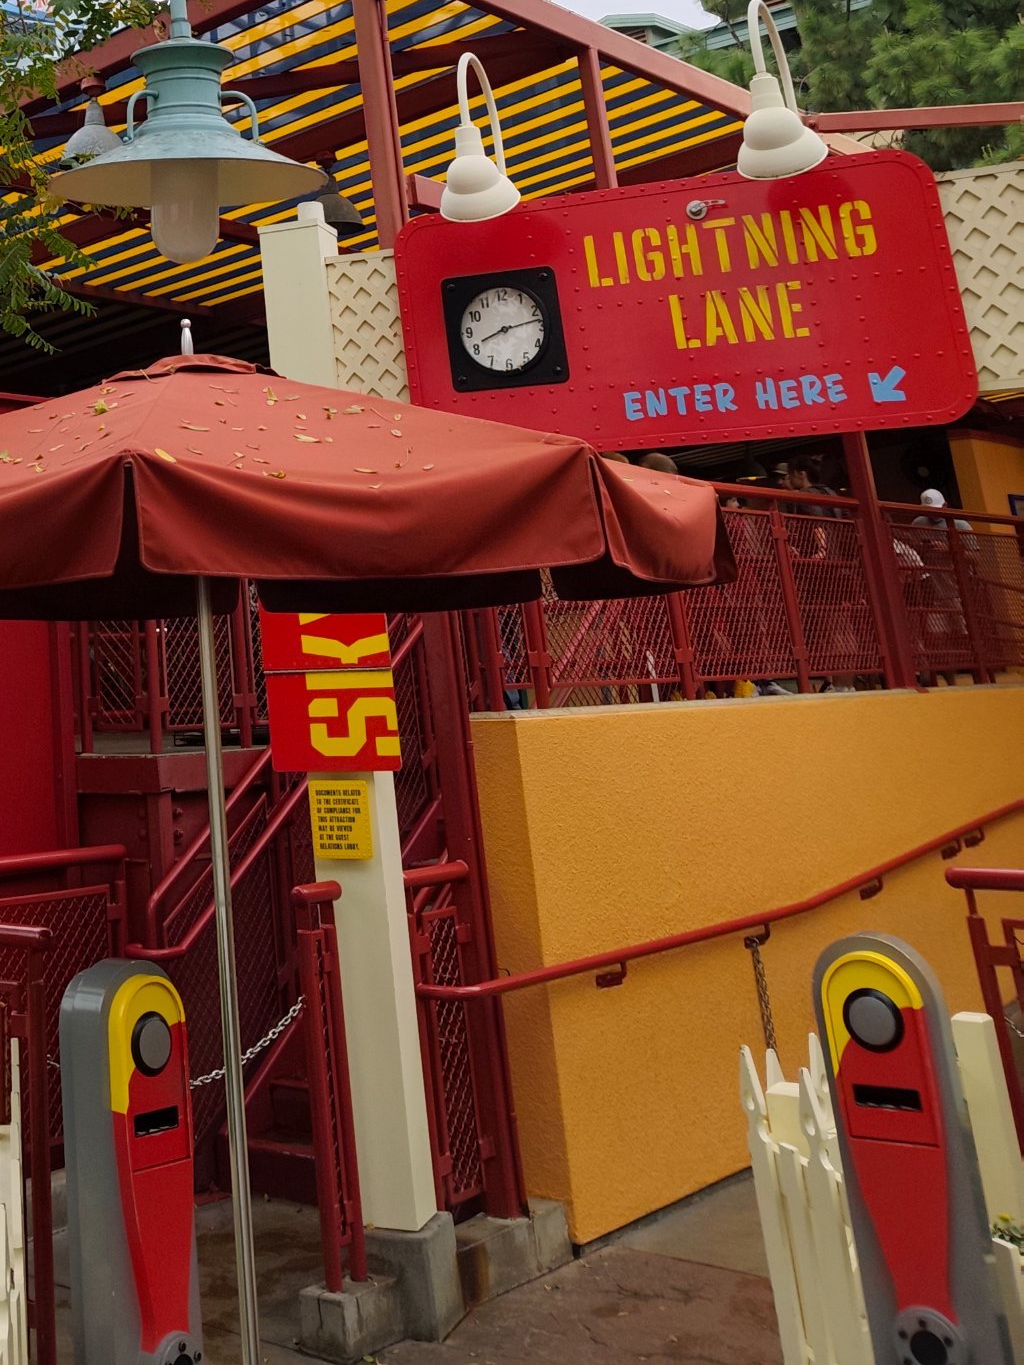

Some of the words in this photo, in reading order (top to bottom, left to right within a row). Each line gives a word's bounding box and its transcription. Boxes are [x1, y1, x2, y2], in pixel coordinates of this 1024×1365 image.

[583, 200, 878, 288] LIGHTNING
[496, 288, 508, 302] 12
[517, 293, 523, 305] 1
[479, 297, 490, 309] 11
[468, 310, 481, 323] 10
[531, 305, 539, 317] 2
[668, 280, 810, 350] LANE
[537, 318, 545, 332] 3
[465, 326, 474, 339] 9
[473, 343, 481, 356] 8
[534, 338, 542, 349] 4
[487, 355, 495, 368] 7
[522, 351, 530, 364] 5
[505, 358, 514, 371] 6
[623, 383, 739, 421] ENTER
[755, 374, 848, 411] HERE
[298, 613, 401, 757] SK
